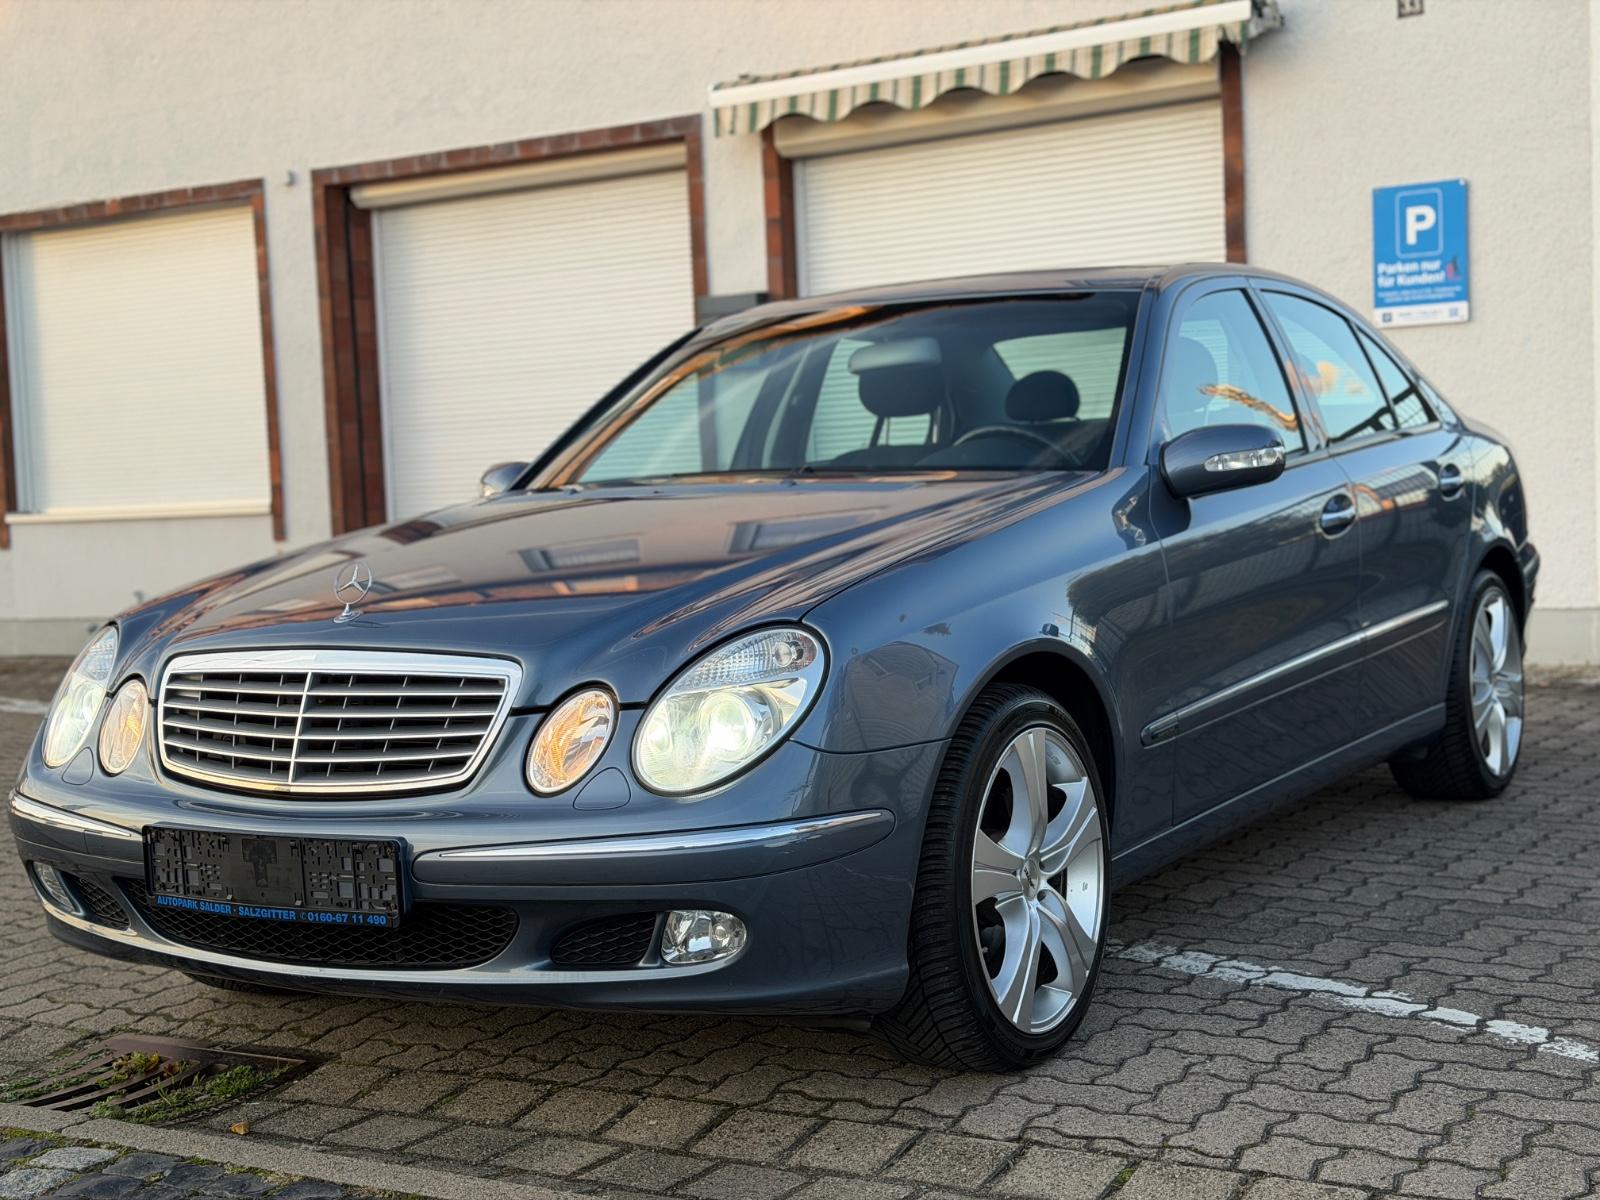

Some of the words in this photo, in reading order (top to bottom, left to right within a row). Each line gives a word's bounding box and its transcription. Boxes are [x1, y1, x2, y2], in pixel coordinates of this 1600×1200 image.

[1405, 205, 1437, 246] P
[1377, 261, 1419, 274] Parken
[157, 895, 198, 910] AUTOPARK
[199, 901, 232, 914] SALDER
[239, 906, 296, 920] SALZGITTER
[307, 911, 349, 923] 0160-67
[352, 914, 363, 924] 11
[367, 915, 386, 925] 490
